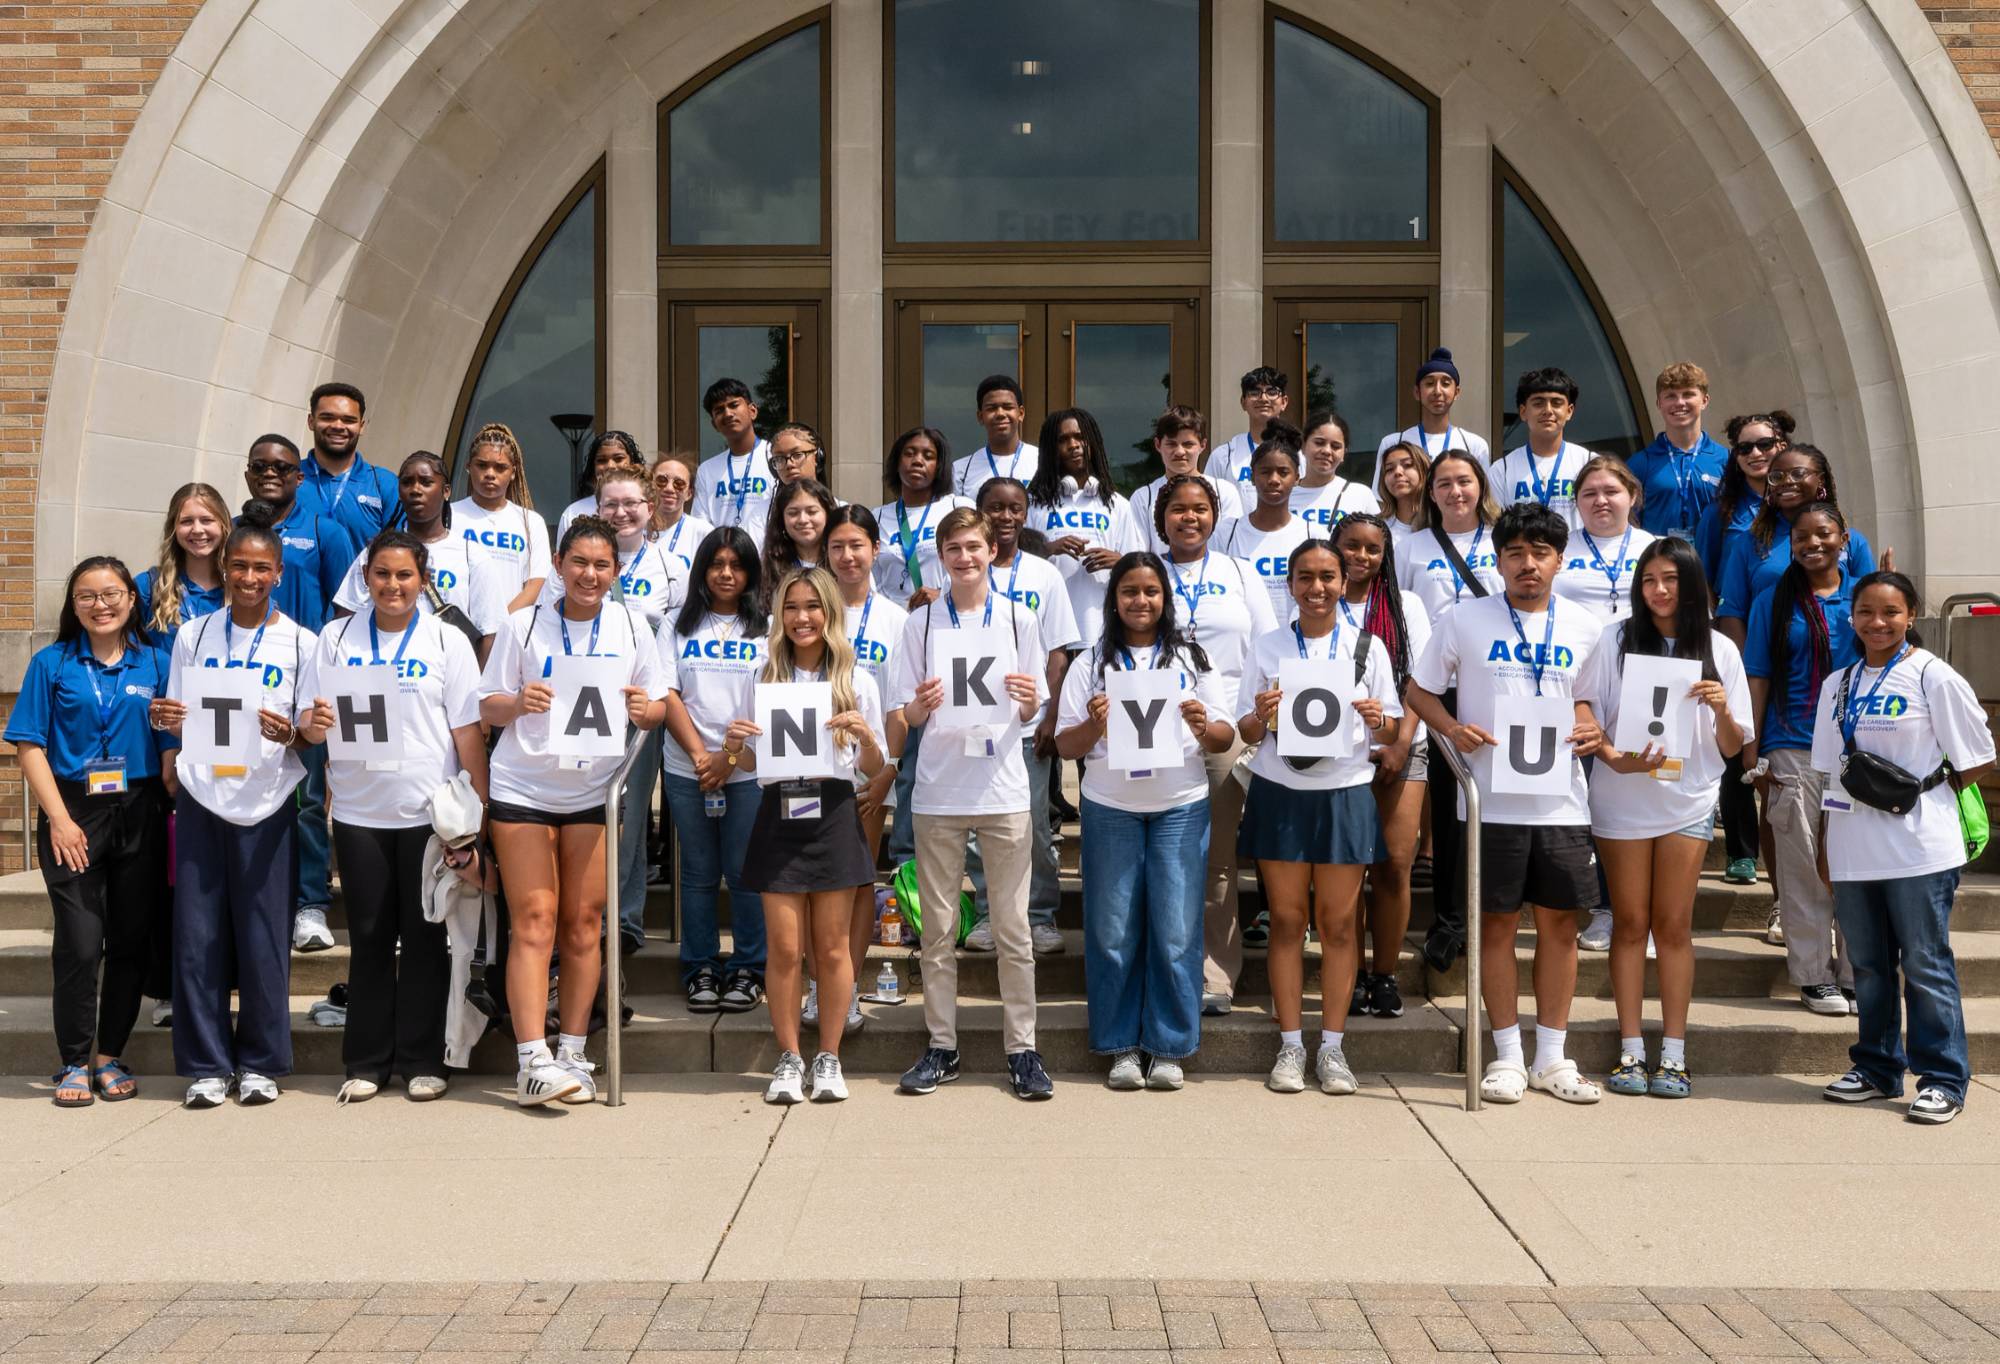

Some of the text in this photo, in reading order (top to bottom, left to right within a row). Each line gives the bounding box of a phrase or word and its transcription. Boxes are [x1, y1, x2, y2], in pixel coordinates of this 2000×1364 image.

[1408, 216, 1419, 239] 1
[715, 477, 767, 497] ACED
[463, 528, 525, 552] ACED
[1046, 511, 1110, 531] ACED
[1427, 553, 1497, 570] AED
[682, 639, 757, 661] ACED
[1487, 640, 1573, 669] ACED
[952, 657, 998, 706] K
[202, 697, 242, 746] T
[336, 695, 388, 742] H
[564, 686, 612, 736] A
[771, 708, 817, 757] N
[1121, 699, 1167, 749] Y
[1292, 687, 1340, 737] O
[1647, 686, 1668, 736] !
[1509, 725, 1556, 775] U
